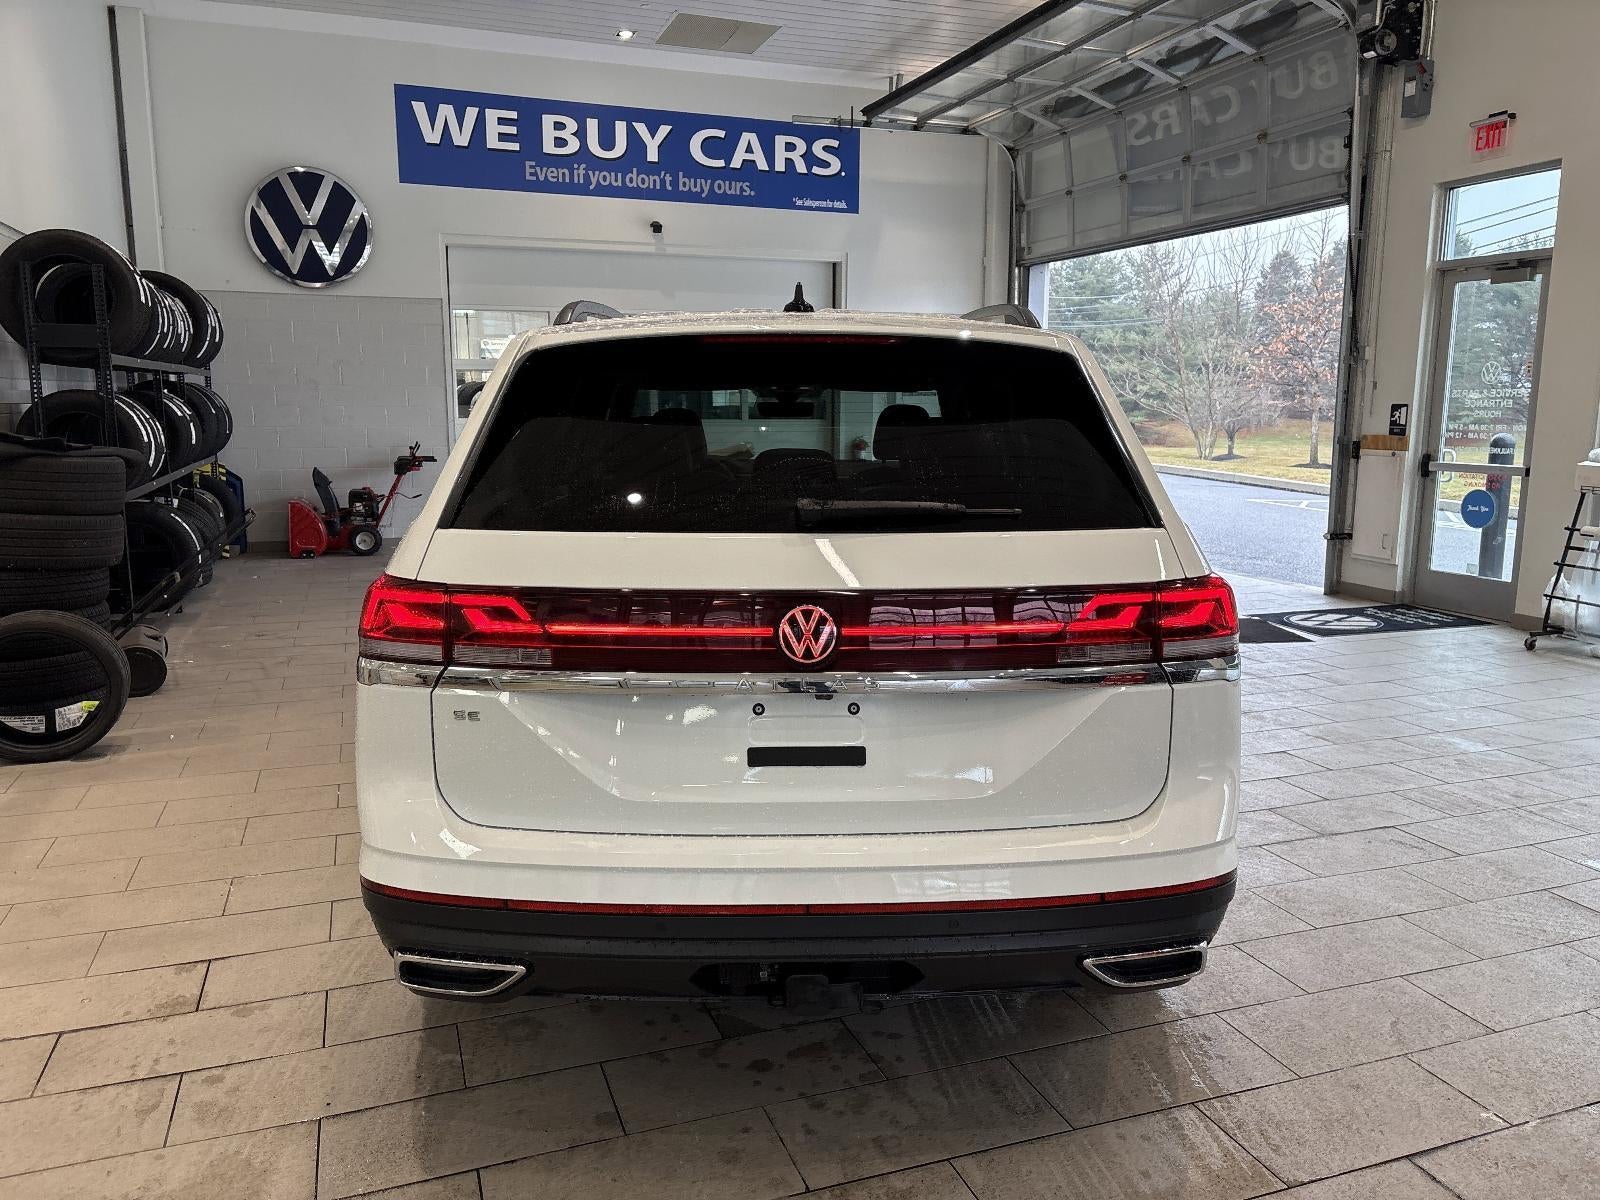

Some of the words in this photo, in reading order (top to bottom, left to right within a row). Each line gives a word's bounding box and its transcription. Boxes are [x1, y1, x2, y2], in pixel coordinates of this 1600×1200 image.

[411, 100, 520, 151] WE
[542, 114, 673, 162] BUY
[689, 128, 846, 177] CARS.
[1475, 121, 1507, 151] EXIT
[525, 160, 569, 183] Even
[573, 163, 587, 184] if
[588, 169, 622, 190] you
[626, 168, 673, 190] don't
[678, 171, 711, 198] buy
[714, 178, 756, 197] ours.
[735, 677, 881, 694] ATLAS
[453, 710, 481, 722] SE
